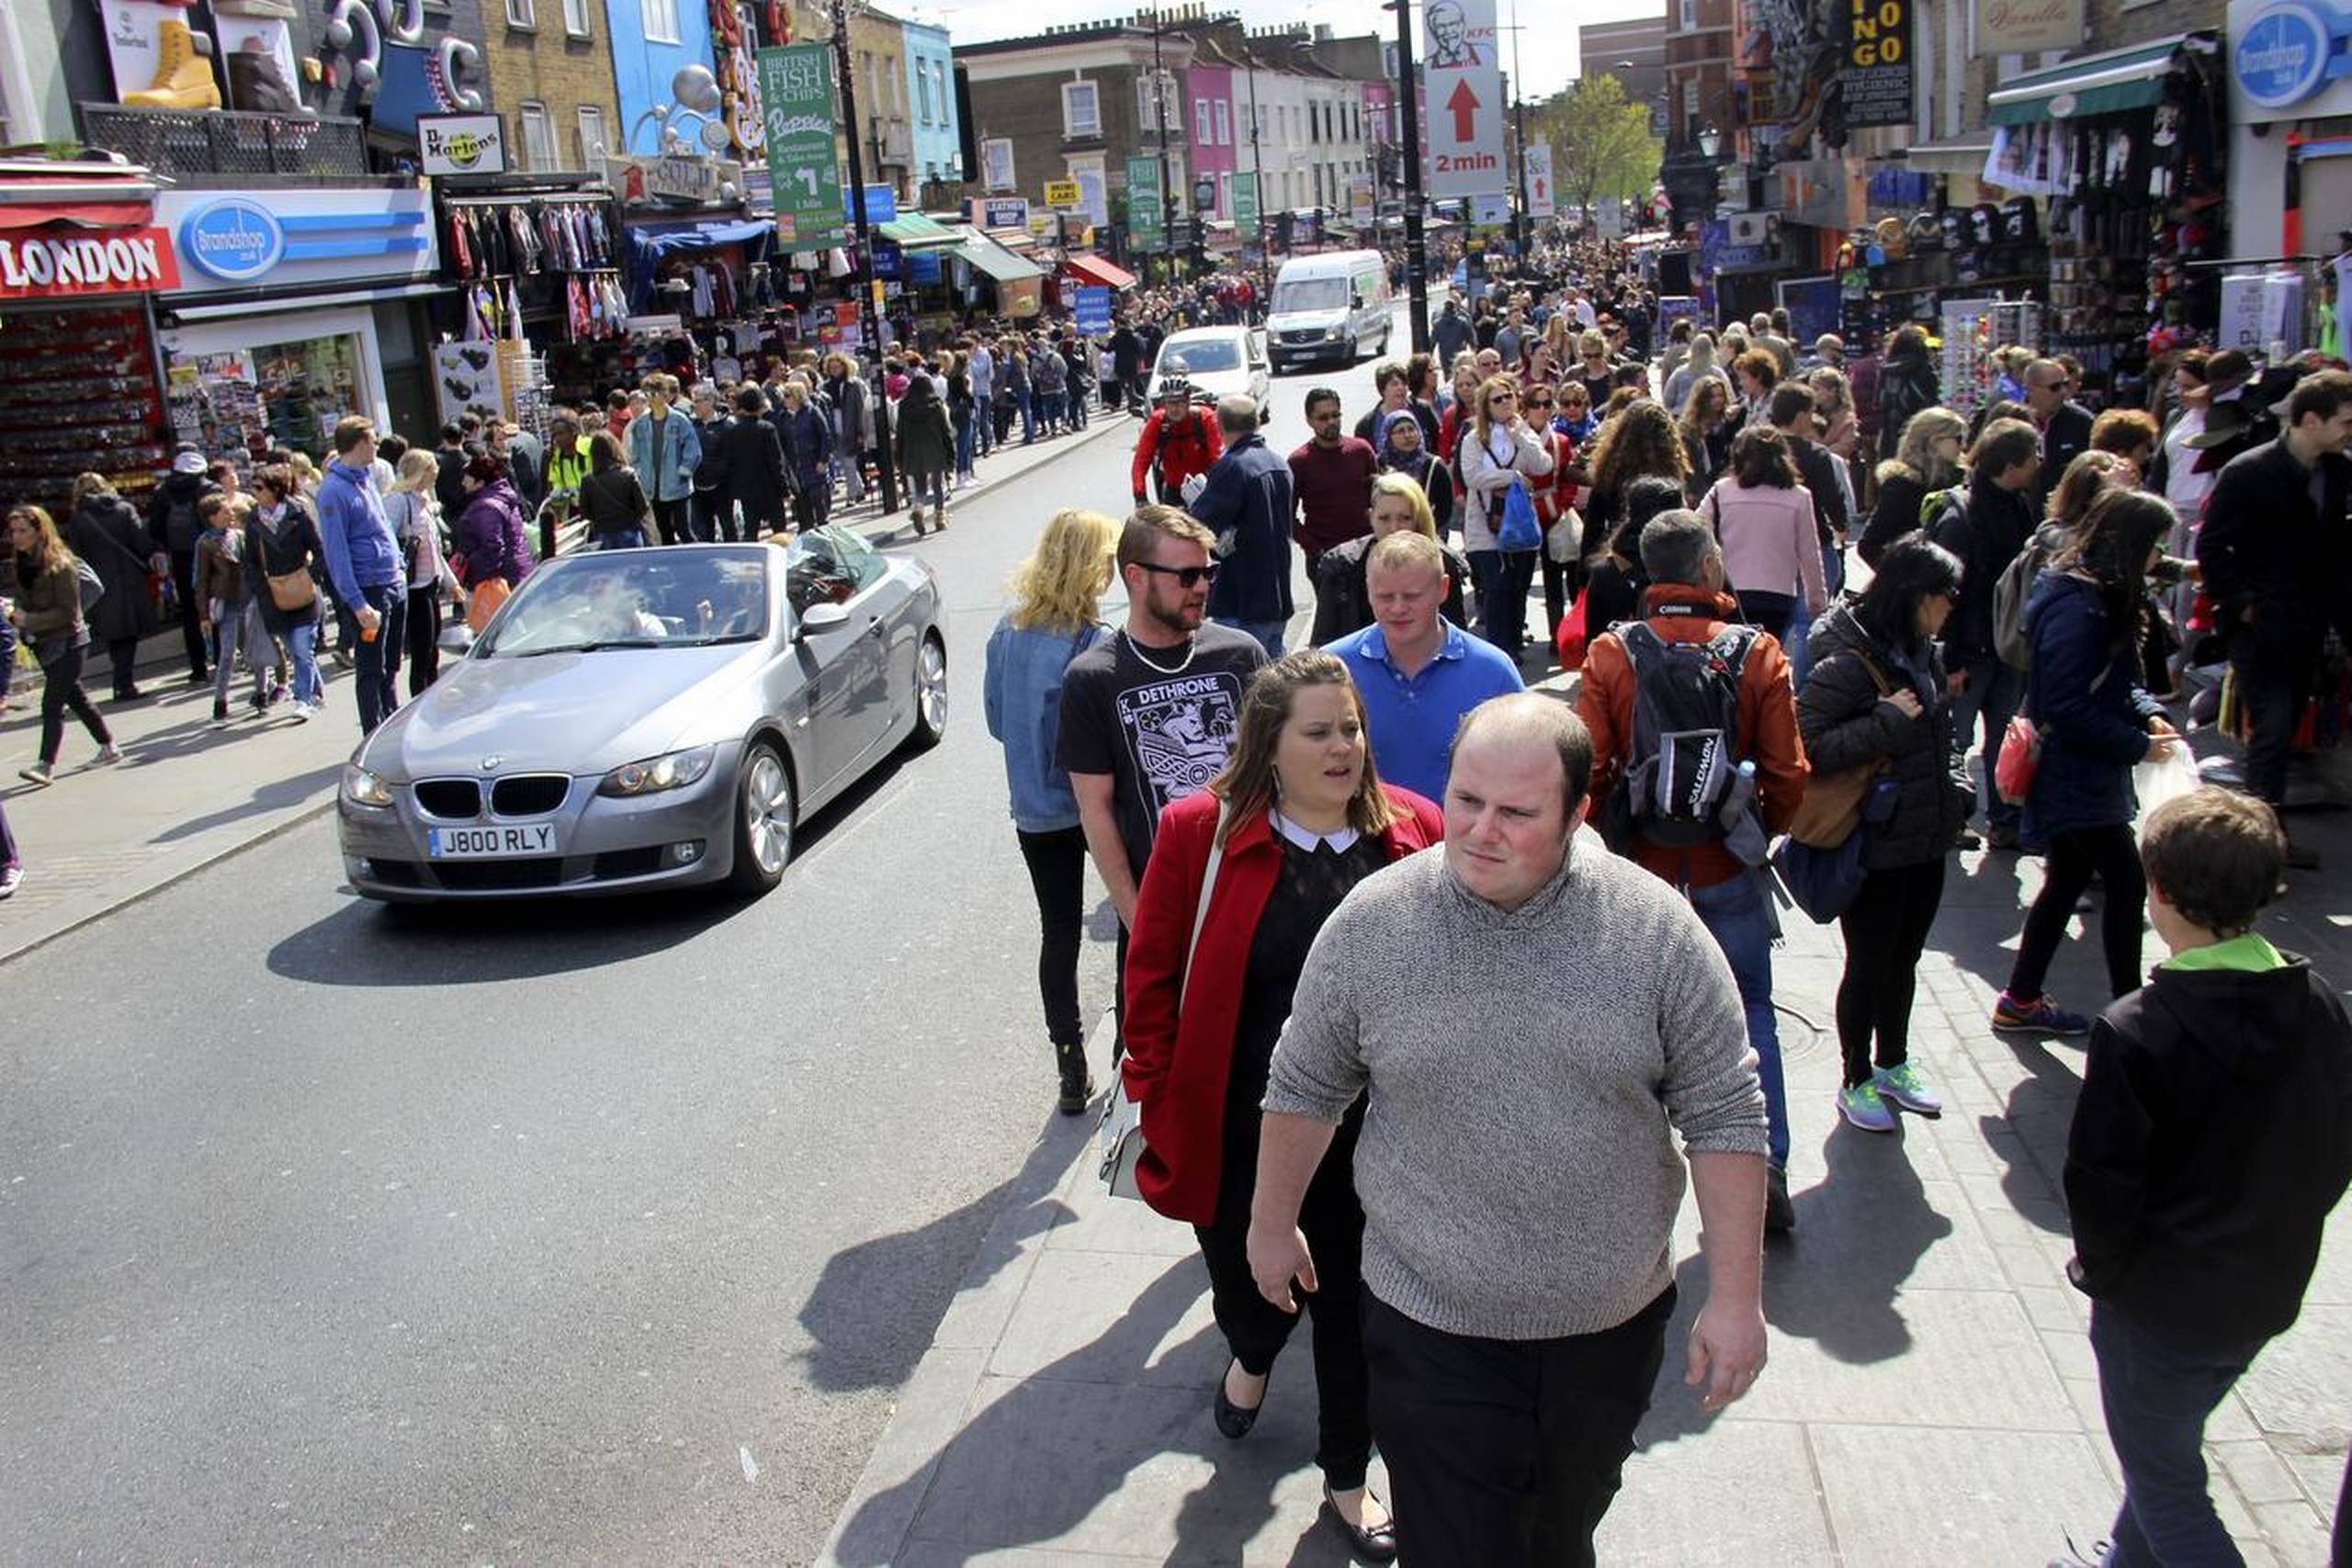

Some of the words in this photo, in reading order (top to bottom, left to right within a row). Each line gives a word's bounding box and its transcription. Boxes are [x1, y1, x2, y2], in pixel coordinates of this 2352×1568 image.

[1466, 28, 1494, 38] KFC
[765, 53, 820, 71] BRITISH
[768, 67, 823, 90] FISH
[769, 93, 780, 103] &
[783, 88, 824, 103] CHIPS
[766, 107, 832, 141] Poppies
[428, 133, 497, 156] Martens
[1436, 154, 1450, 172] 2
[1453, 151, 1497, 170] min
[986, 202, 1024, 211] LEATHER
[0, 237, 160, 287] LONDON
[1139, 677, 1219, 705] DETHRONE
[1120, 698, 1131, 714] K
[1688, 737, 1714, 805] SALOMON
[446, 830, 499, 852] J800
[506, 827, 549, 851] RLY
